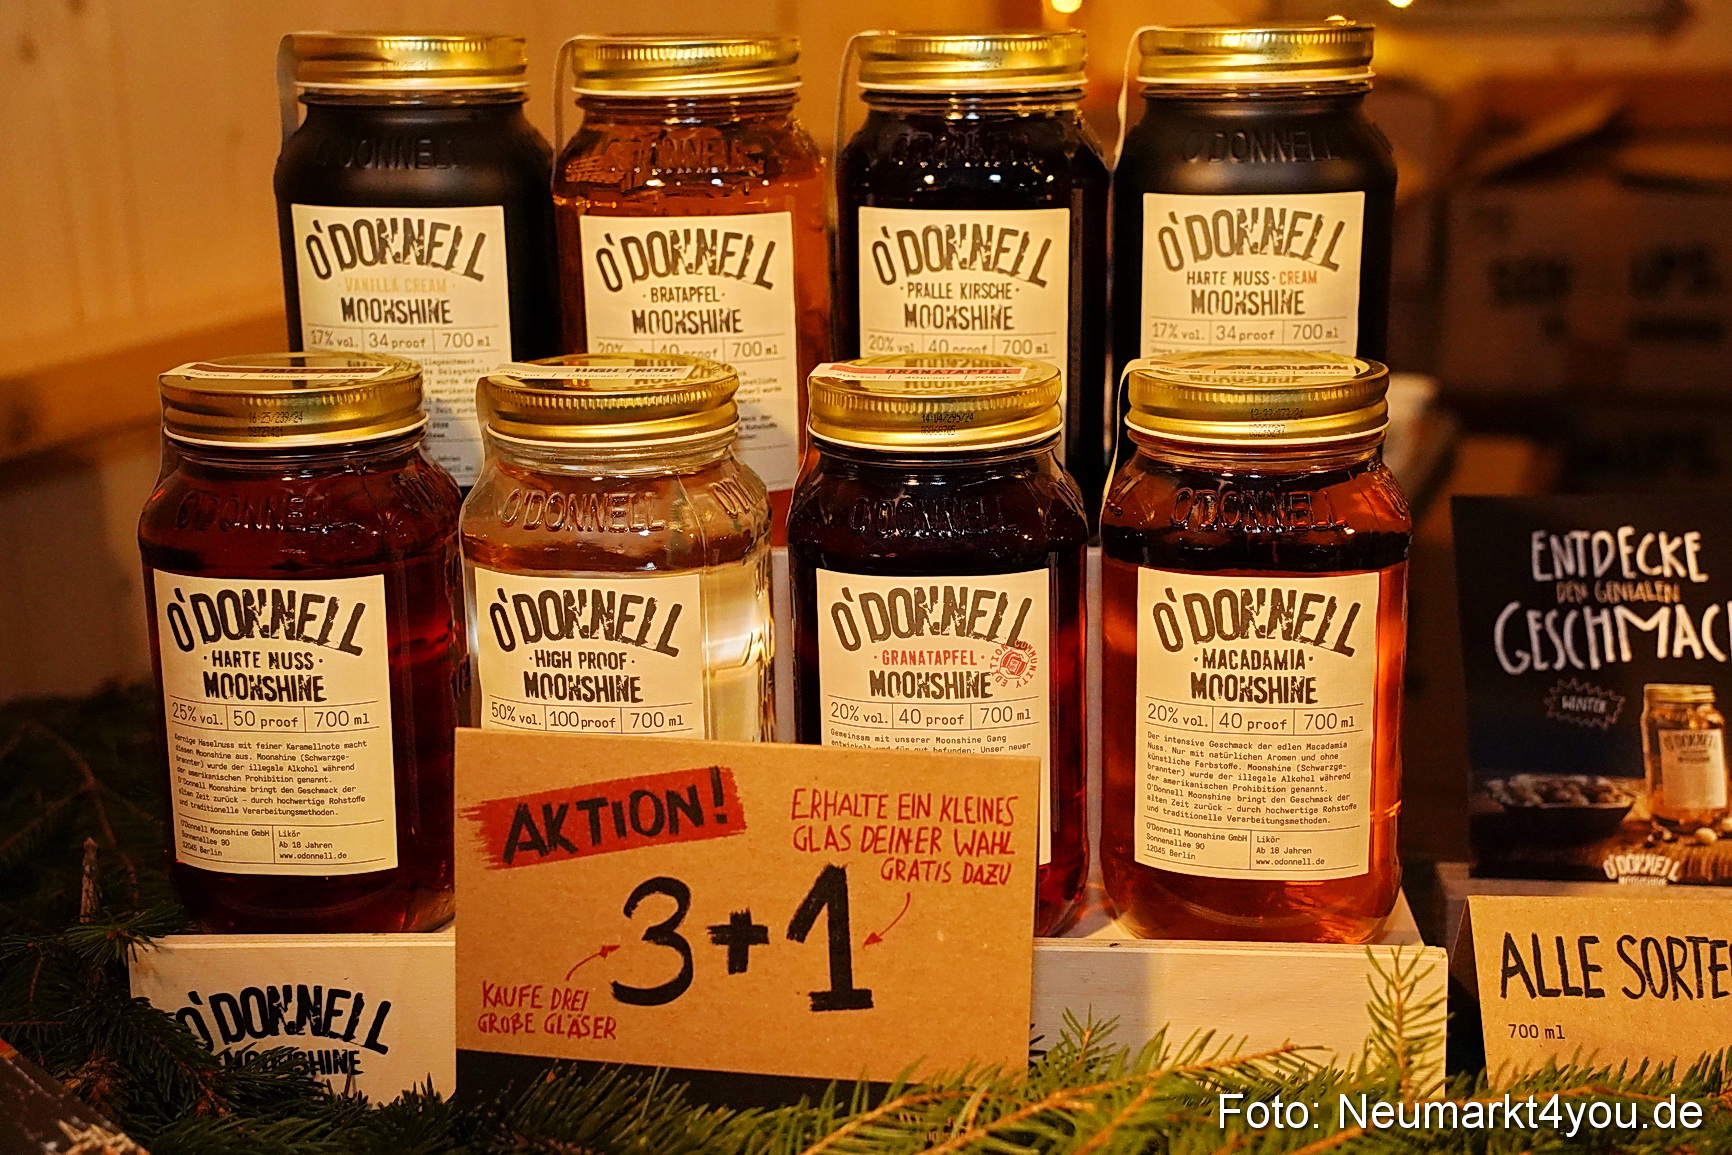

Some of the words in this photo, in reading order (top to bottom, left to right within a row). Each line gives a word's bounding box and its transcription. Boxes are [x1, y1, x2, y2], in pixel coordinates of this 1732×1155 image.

[1158, 207, 1345, 272] O'DONNELL
[306, 218, 486, 282] O'DONNELL
[596, 228, 775, 292] O'DONNELL
[871, 224, 1052, 288] O'DONNELL
[345, 278, 398, 293] VANILLA
[405, 278, 446, 293] CREAM
[1187, 271, 1226, 285] HARTE
[1233, 271, 1269, 285] NUSS
[1280, 271, 1317, 284] CREAM
[651, 286, 720, 302] BRATAPFEL
[908, 282, 952, 299] PRALLE
[960, 283, 1012, 299] KIRSCHE
[341, 297, 453, 324] MOONSHINE
[1191, 289, 1305, 316] MOONSHINE
[632, 309, 743, 334] MOONSHINE
[904, 304, 1014, 330] MOONSHINE
[311, 330, 334, 344] 17%
[337, 337, 358, 347] vol.
[369, 333, 388, 348] 34
[392, 338, 426, 348] proof
[442, 333, 474, 348] 700
[477, 336, 490, 346] ml
[1153, 323, 1178, 339] 17%
[1182, 329, 1204, 340] vol.
[1216, 326, 1236, 340] 34
[1239, 330, 1275, 342] proof
[1292, 324, 1322, 340] 700
[1326, 327, 1338, 338] ml
[732, 342, 762, 357] 700
[766, 344, 778, 355] ml
[868, 335, 894, 353] 20%
[929, 339, 949, 353] 40
[1003, 339, 1032, 355] 700
[1036, 344, 1048, 354] ml
[1532, 525, 1709, 582] ENTDECKE
[1556, 581, 1588, 603] DEN
[1595, 581, 1680, 603] GENIALEN
[167, 588, 365, 656] O'DONNELL
[490, 588, 682, 657] O'DONNELL
[831, 586, 1032, 651] O'DONNELL
[1153, 588, 1361, 657] O'DONNELL
[1494, 601, 1732, 675] GESCHMAC
[212, 651, 261, 668] HARTE
[268, 652, 314, 670] NUSS
[535, 650, 572, 668] HIGH
[579, 652, 627, 670] PROOF
[882, 650, 977, 666] GRANATAPFEL
[990, 643, 1008, 687] EDITION
[1203, 649, 1305, 670] MACADAMIA
[203, 671, 327, 702] MOONSHINE
[524, 671, 643, 703] MOONSHINE
[869, 670, 993, 699] MOONSHINE
[1191, 672, 1318, 704] MOONSHINE
[172, 702, 197, 722] 25%
[200, 713, 223, 725] vol.
[234, 710, 255, 727] 50
[261, 717, 298, 729] proof
[314, 710, 349, 727] 700
[354, 714, 369, 724] ml
[491, 702, 515, 722] 50%
[519, 714, 542, 725] vol.
[550, 711, 578, 727] 100
[581, 718, 616, 729] proof
[630, 712, 664, 728] 700
[669, 715, 683, 726] ml
[831, 702, 859, 721] 20%
[864, 713, 888, 723] vol.
[899, 709, 921, 724] 40
[926, 715, 964, 726] proof
[980, 706, 1013, 724] 700
[1017, 709, 1031, 719] ml
[1148, 703, 1178, 723] 20%
[1183, 716, 1208, 727] vol.
[1219, 713, 1242, 729] 40
[1248, 719, 1287, 731] proof
[1304, 714, 1337, 730] 700
[1341, 716, 1354, 728] ml
[831, 728, 870, 742] Gemeinsam
[936, 736, 981, 744] Moonshine
[987, 735, 1006, 744] Gang
[1148, 731, 1160, 740] Der
[1164, 735, 1204, 747] intensive
[1209, 740, 1252, 749] Geschmack
[1258, 742, 1272, 750] der
[1306, 742, 1347, 750] Macadamia
[981, 746, 1005, 754] Unser
[1009, 742, 1031, 751] neuer
[1148, 742, 1167, 752] Nuss.
[1190, 749, 1204, 757] mit
[1209, 751, 1262, 760] natürlichen
[1267, 753, 1296, 761] Aromen
[1320, 752, 1338, 760] ohne
[503, 765, 729, 865] AKTION!
[791, 788, 889, 821] ERHALTE
[898, 793, 931, 820] EIN
[940, 795, 1018, 826] KLEINES
[279, 830, 300, 838] Likör
[793, 825, 851, 852] GLAS
[861, 825, 942, 855] DEINER
[954, 829, 1015, 857] WAHL
[1147, 823, 1181, 836] O'Donnell
[1184, 830, 1225, 840] Moonshine
[1228, 834, 1248, 842] GmbH
[1147, 833, 1191, 848] Sonnenallee
[1196, 842, 1205, 850] 90
[1257, 835, 1280, 843] Likör
[1147, 844, 1165, 854] 12045
[1170, 849, 1195, 860] Berlin
[881, 857, 951, 883] GRATIS
[963, 862, 1012, 885] DAZU
[1603, 854, 1680, 882] O'DONNELL
[1500, 932, 1605, 1000] ALLE
[1616, 933, 1732, 1001] SORTE
[483, 980, 543, 1008] KAUFE
[551, 988, 589, 1011] DREI
[176, 985, 391, 1055] O'DONNELL
[544, 1013, 616, 1040] GLÄSER
[1508, 1023, 1539, 1039] 700
[1545, 1024, 1566, 1040] ml
